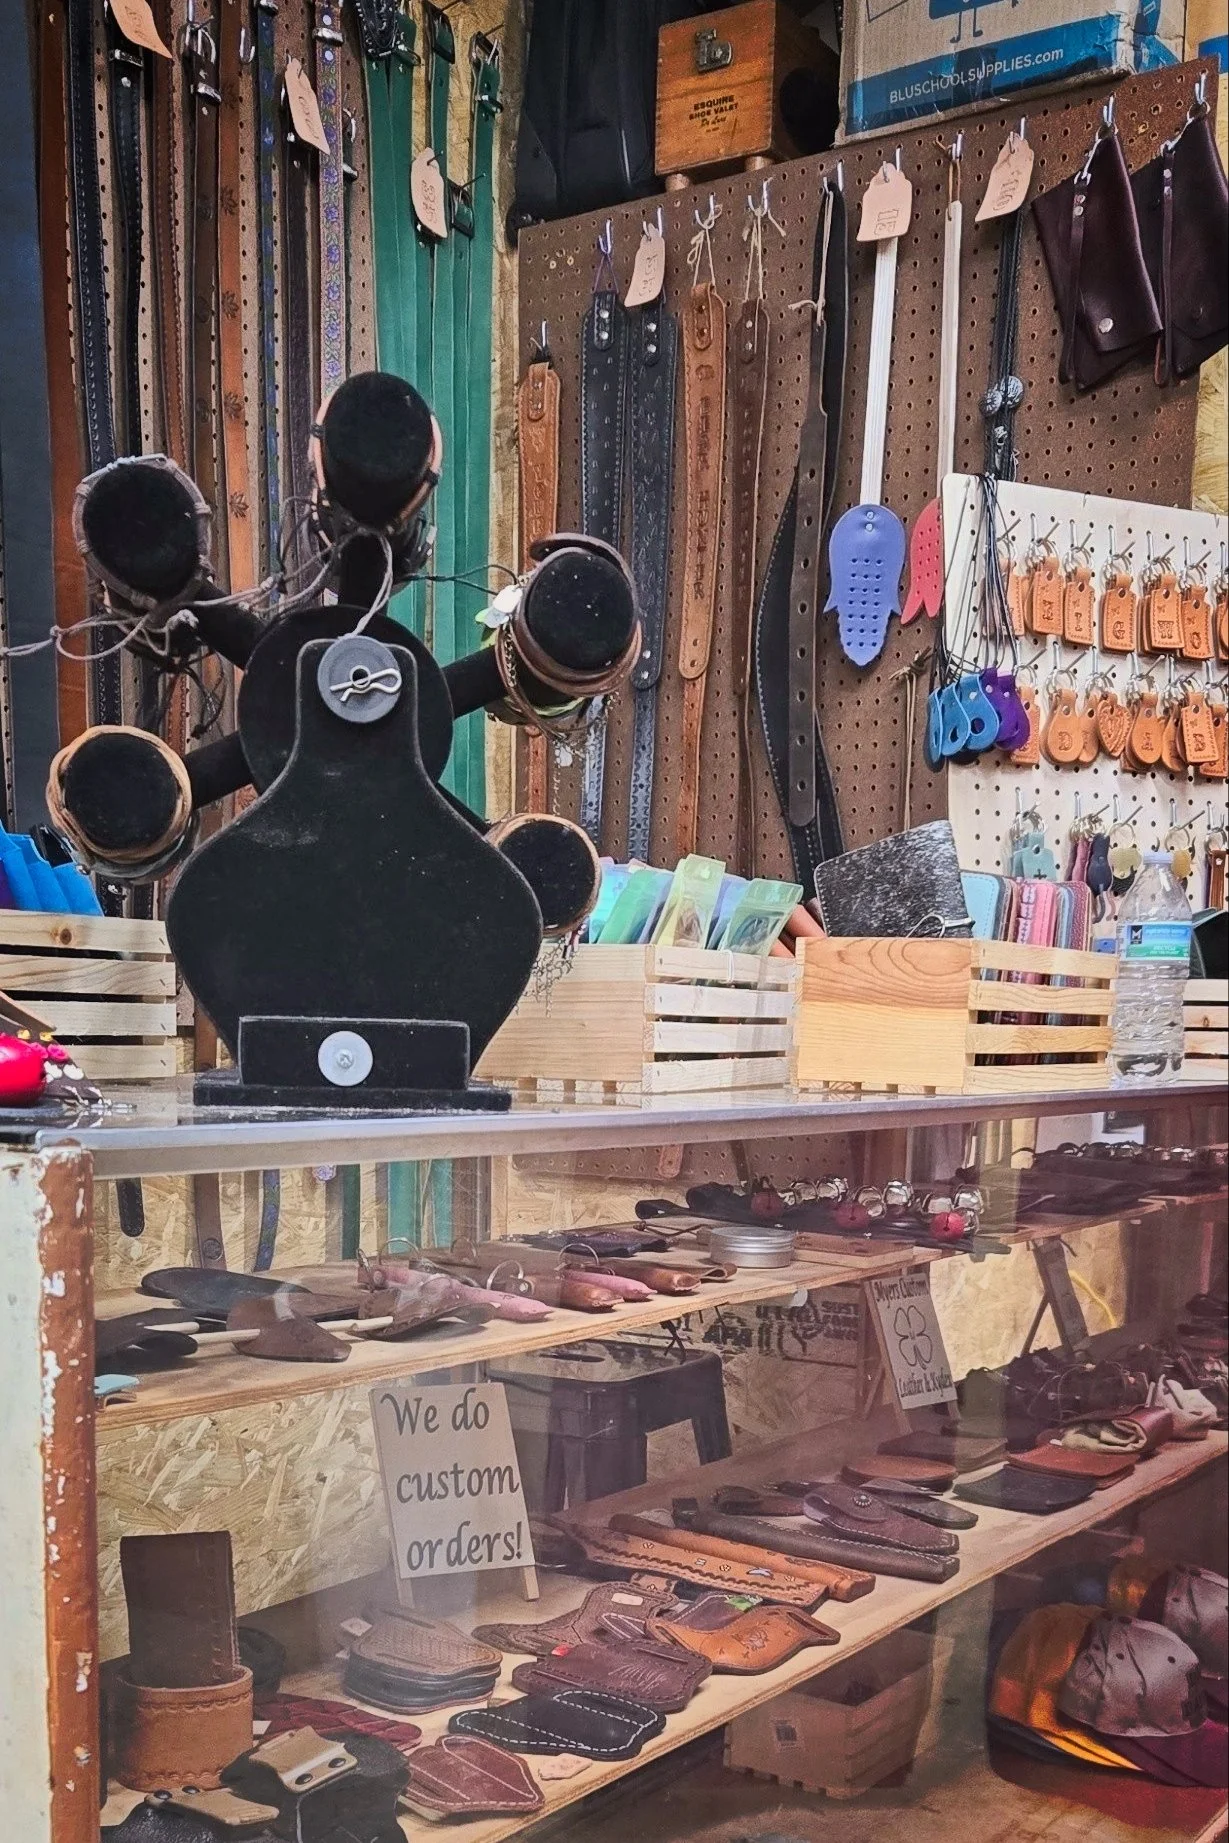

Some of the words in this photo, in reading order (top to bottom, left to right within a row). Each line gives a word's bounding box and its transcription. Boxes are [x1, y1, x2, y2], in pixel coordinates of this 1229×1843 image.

[889, 48, 1065, 104] BLUSCHOOLSUPPLIES.com
[693, 94, 735, 111] ESQUIRE
[714, 102, 739, 115] VALET
[874, 1280, 899, 1309] Myers
[899, 1278, 930, 1299] Custom
[380, 1392, 440, 1436] We
[451, 1387, 490, 1432] do
[396, 1462, 520, 1504] custom
[406, 1520, 522, 1571] orders!
